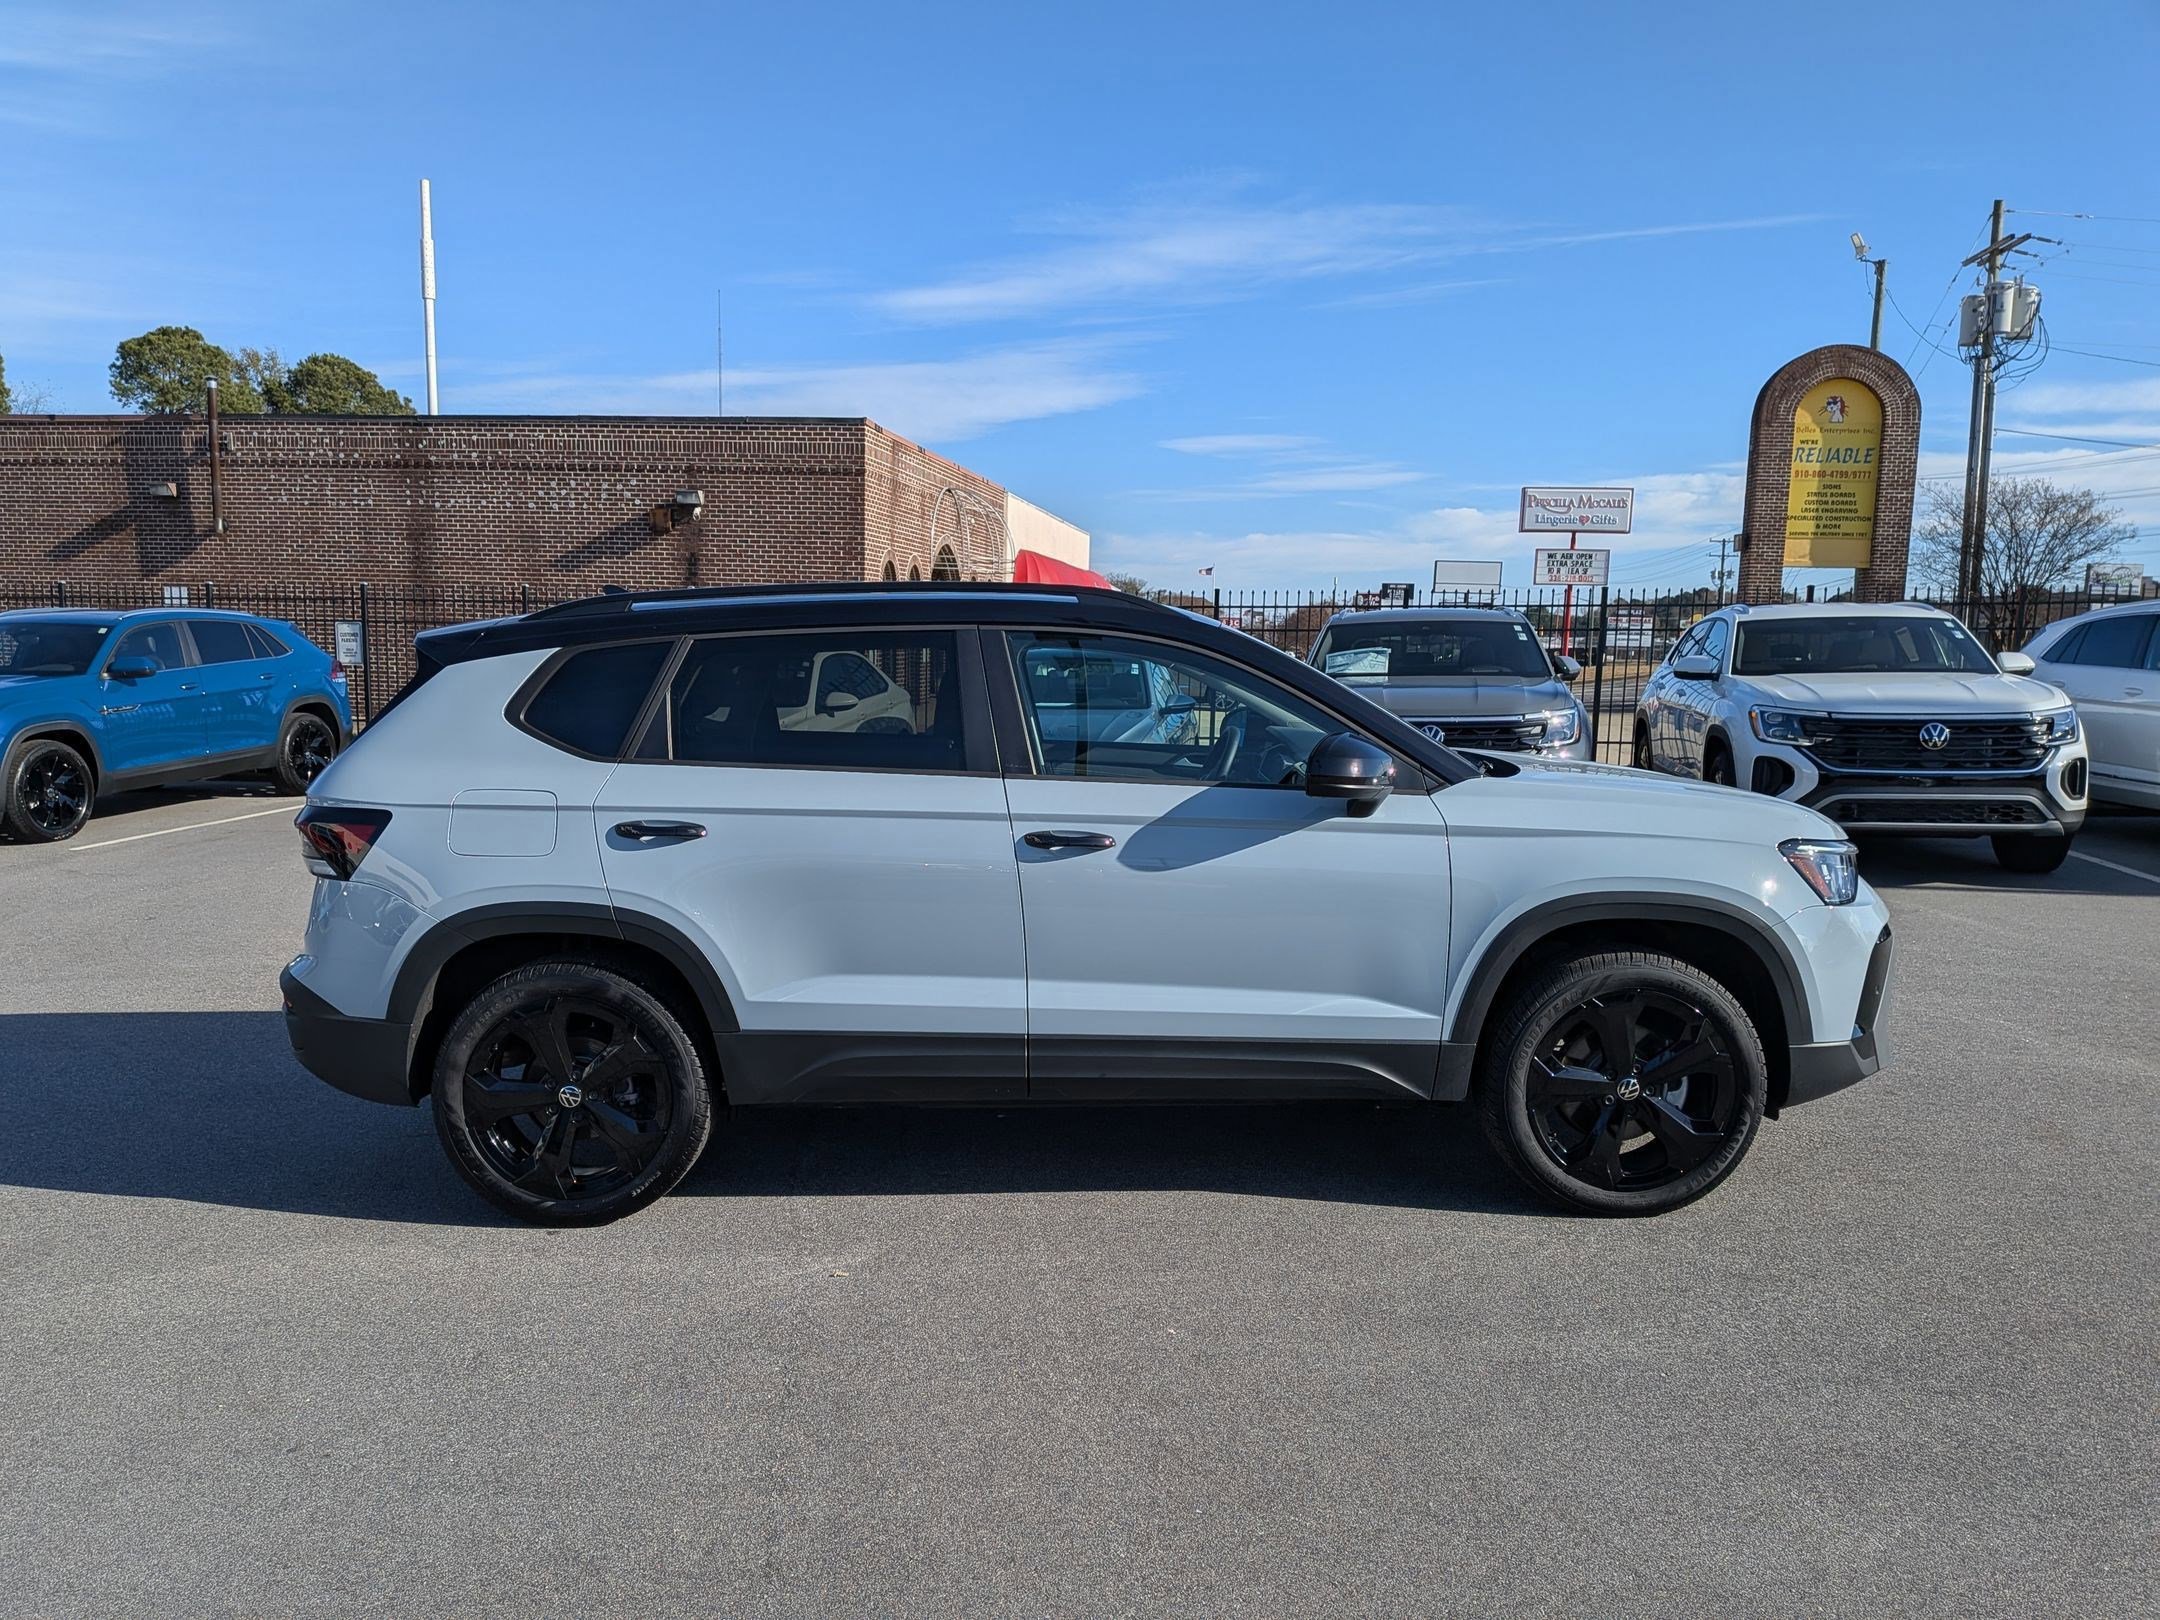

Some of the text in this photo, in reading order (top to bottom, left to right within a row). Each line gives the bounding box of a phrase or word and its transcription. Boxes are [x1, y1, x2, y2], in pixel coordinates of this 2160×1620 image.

[1793, 447, 1876, 464] RELIABLE
[1535, 514, 1618, 526] Lingerie Gifts
